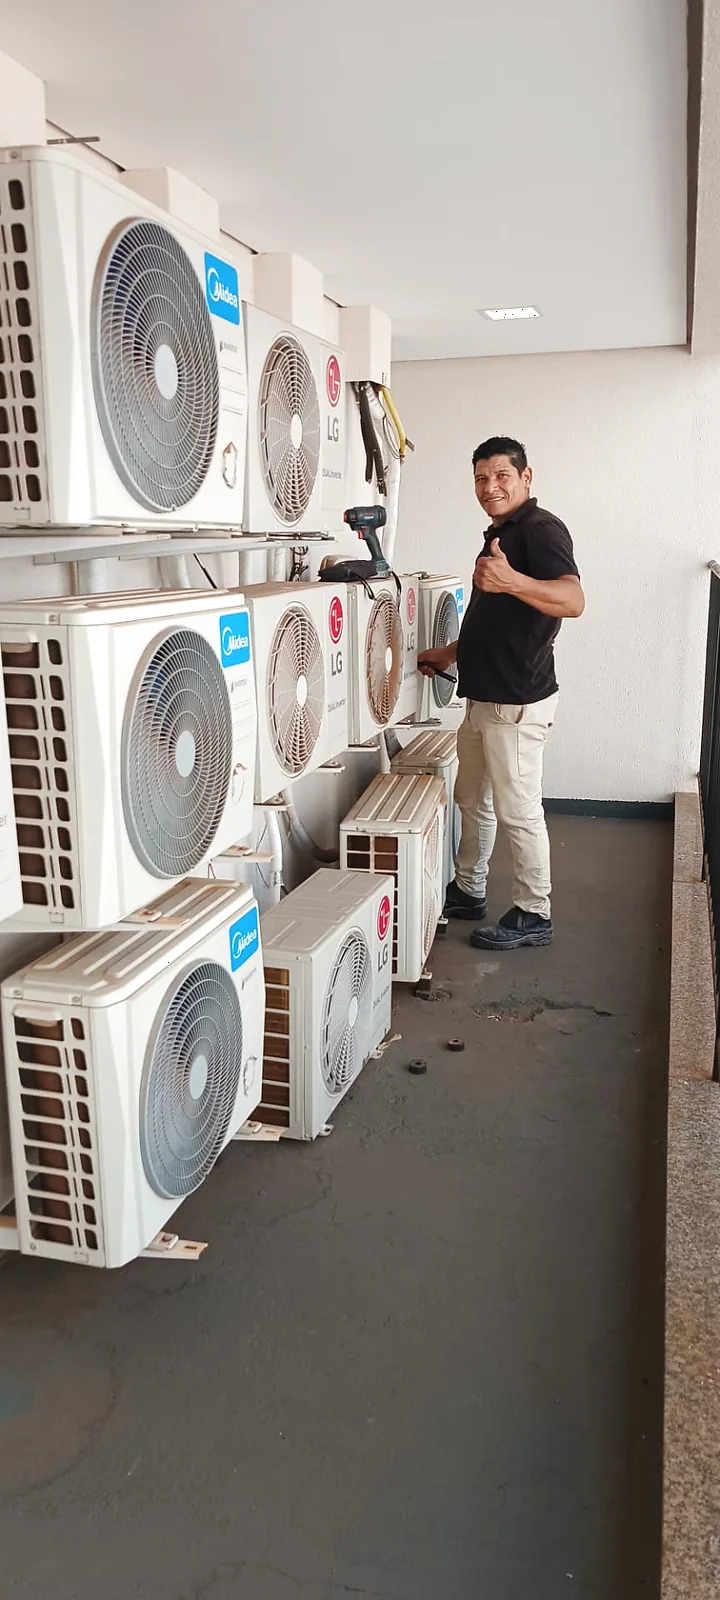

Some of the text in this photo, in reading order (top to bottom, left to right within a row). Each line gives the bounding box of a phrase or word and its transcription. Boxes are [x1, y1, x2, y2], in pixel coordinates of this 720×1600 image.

[208, 267, 238, 308] Midea
[327, 415, 339, 441] LG
[222, 627, 249, 655] Midea
[407, 632, 415, 651] LG
[331, 652, 342, 676] LG
[232, 929, 257, 959] Midea
[378, 943, 388, 973] LG
